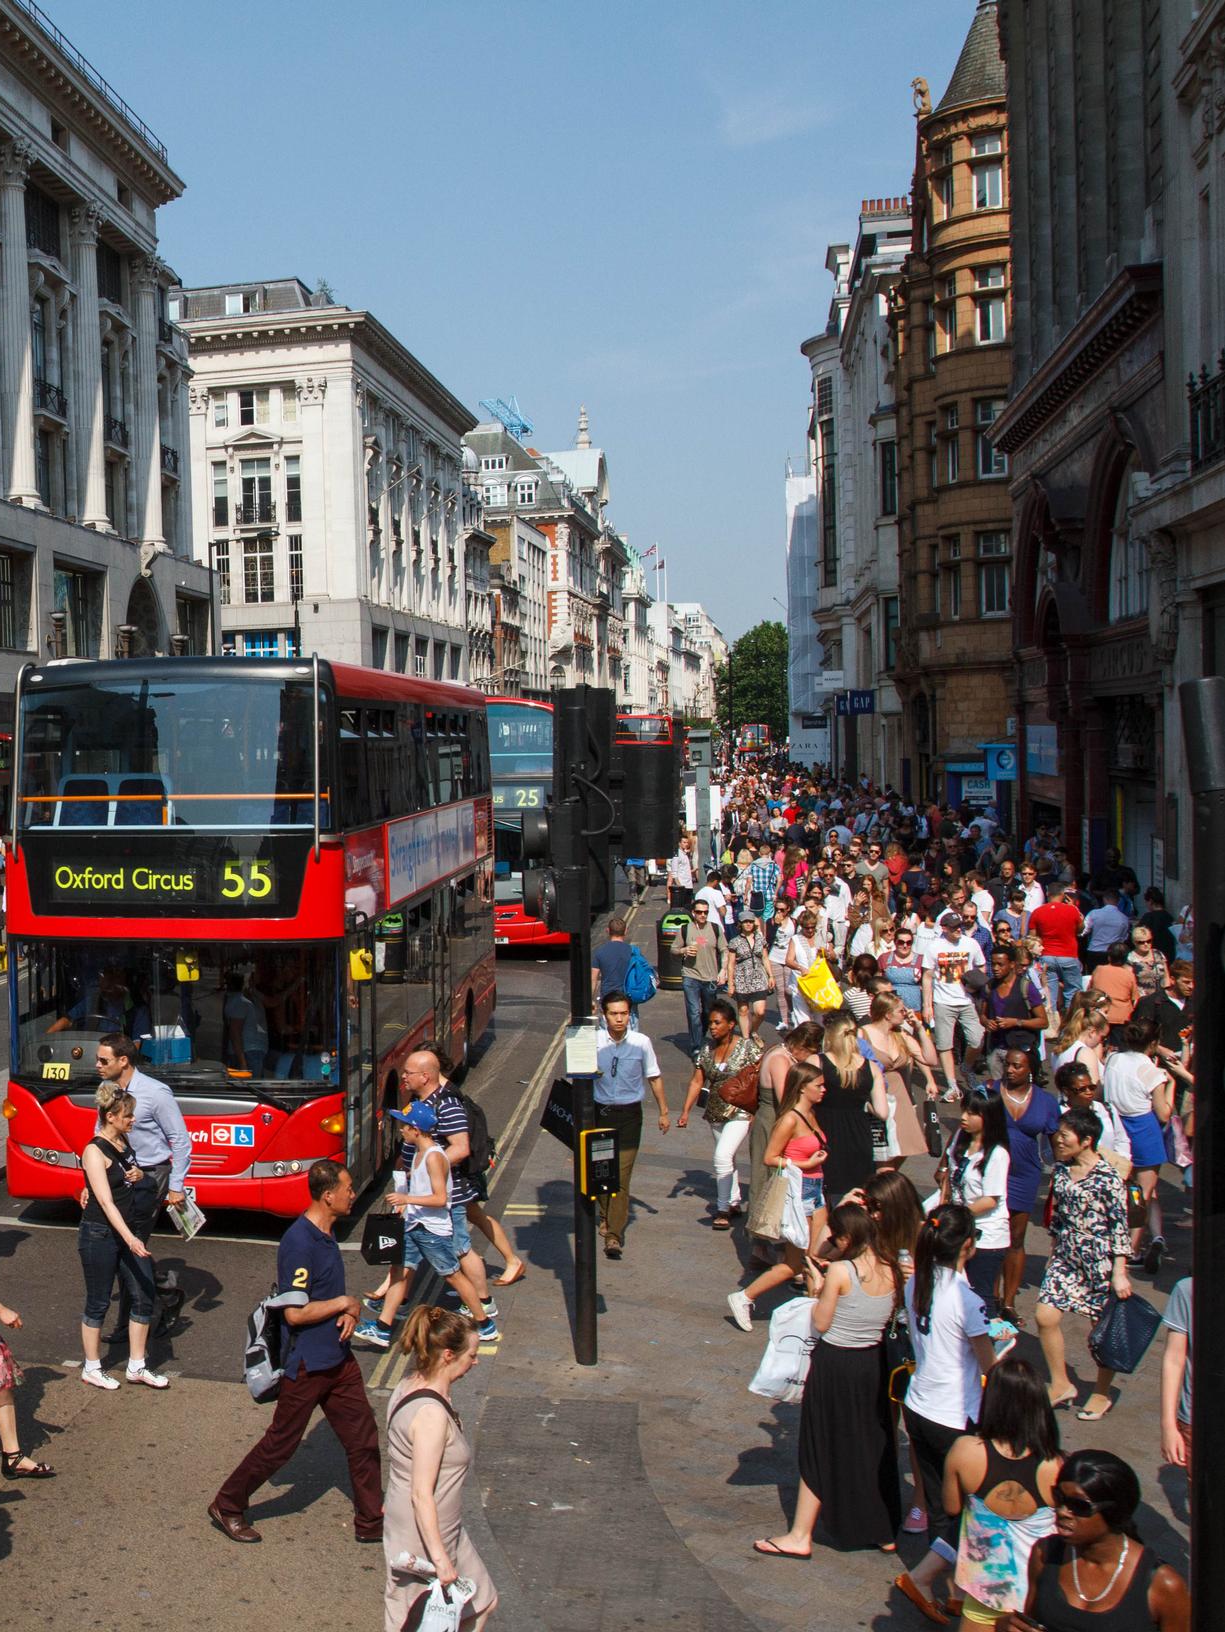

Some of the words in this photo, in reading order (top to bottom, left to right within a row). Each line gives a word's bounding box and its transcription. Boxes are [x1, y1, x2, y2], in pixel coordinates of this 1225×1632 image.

[853, 697, 870, 709] GAP
[967, 780, 991, 789] CASH
[516, 789, 539, 807] 25
[55, 866, 124, 890] Oxford
[132, 868, 194, 890] Circus
[222, 860, 272, 898] 55
[46, 1067, 66, 1080] 130
[292, 1267, 309, 1288] 2
